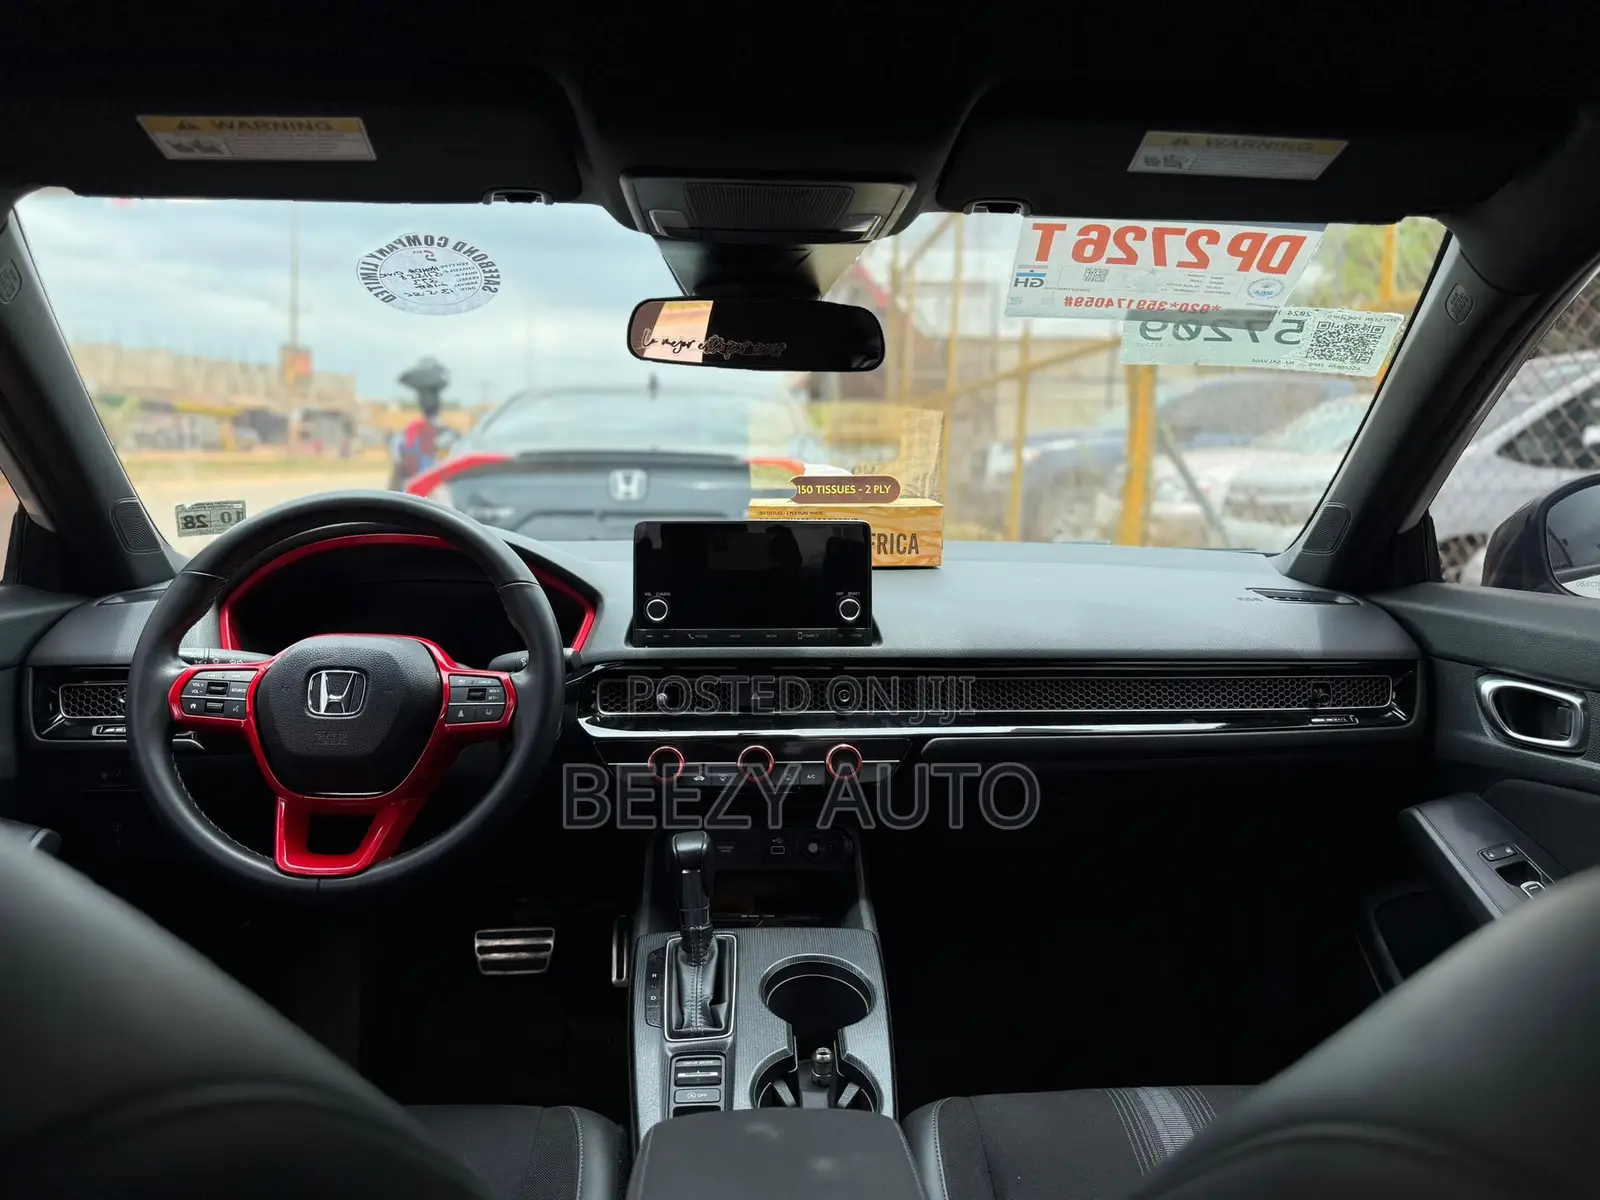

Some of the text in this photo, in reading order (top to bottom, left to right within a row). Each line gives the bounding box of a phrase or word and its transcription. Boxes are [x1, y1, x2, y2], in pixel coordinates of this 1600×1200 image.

[211, 119, 334, 132] WARNING
[1204, 136, 1315, 153] WARNING
[661, 336, 696, 355] mejor
[796, 484, 813, 494] 150
[815, 484, 857, 494] TISSUES
[865, 484, 871, 494] 2
[873, 484, 892, 494] PLY
